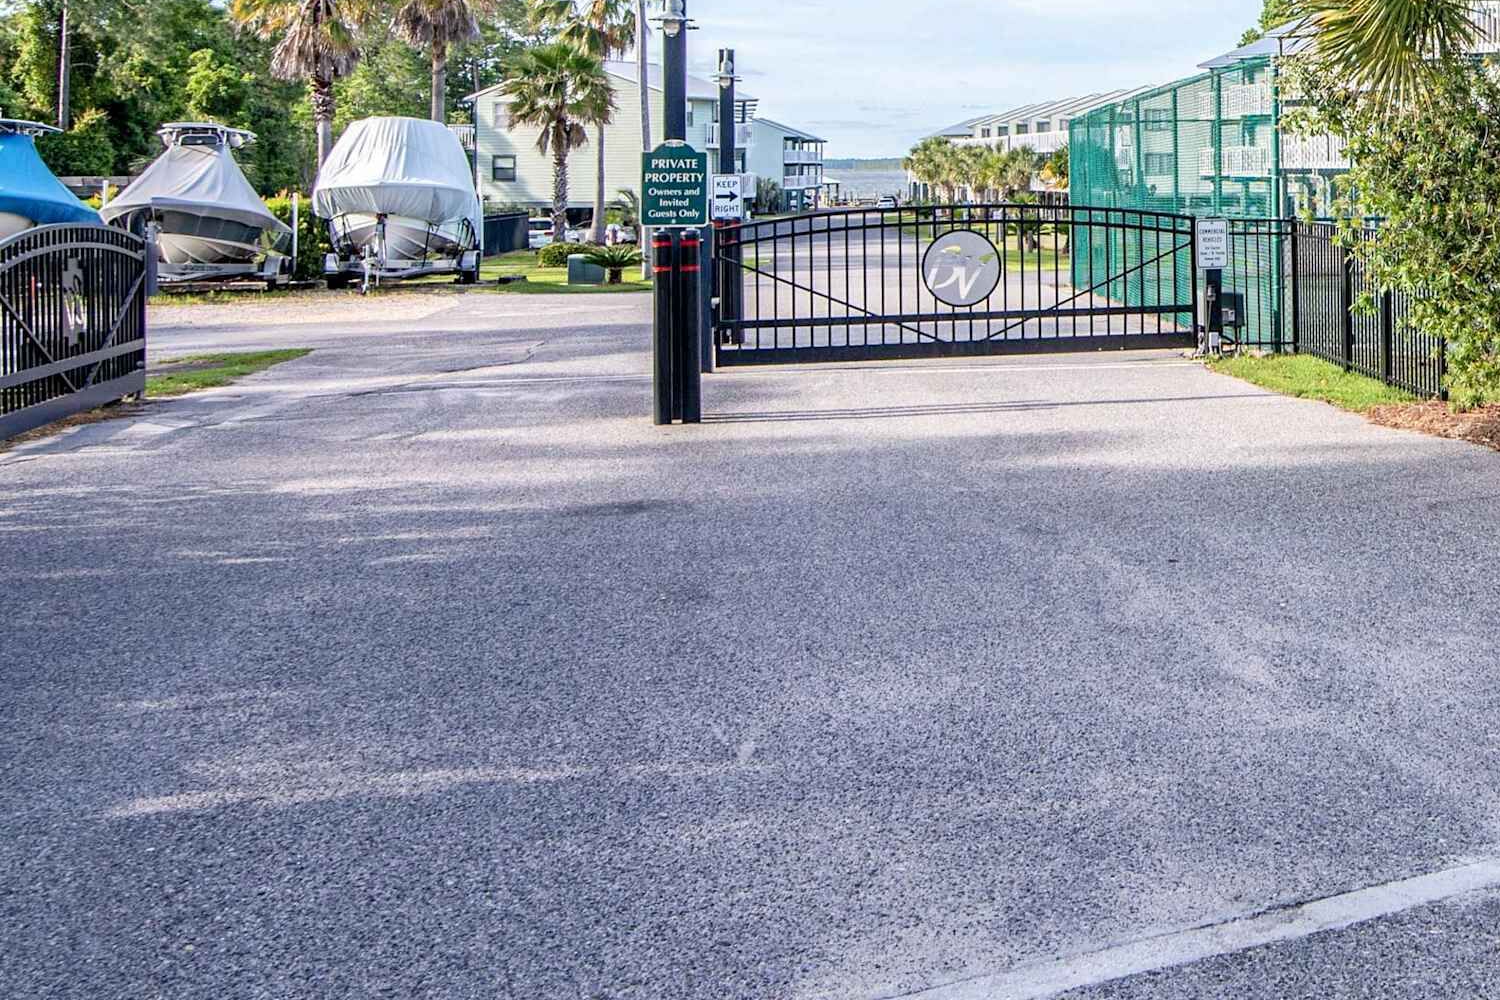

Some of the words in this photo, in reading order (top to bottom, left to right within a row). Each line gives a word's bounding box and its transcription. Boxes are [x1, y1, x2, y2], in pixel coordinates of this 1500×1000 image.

[651, 159, 698, 169] PRIVATE
[644, 173, 704, 183] PROPERTY
[648, 187, 682, 196] Owners
[683, 187, 700, 196] and
[659, 199, 689, 207] Invited
[648, 210, 677, 218] Guests
[678, 209, 700, 219] Only
